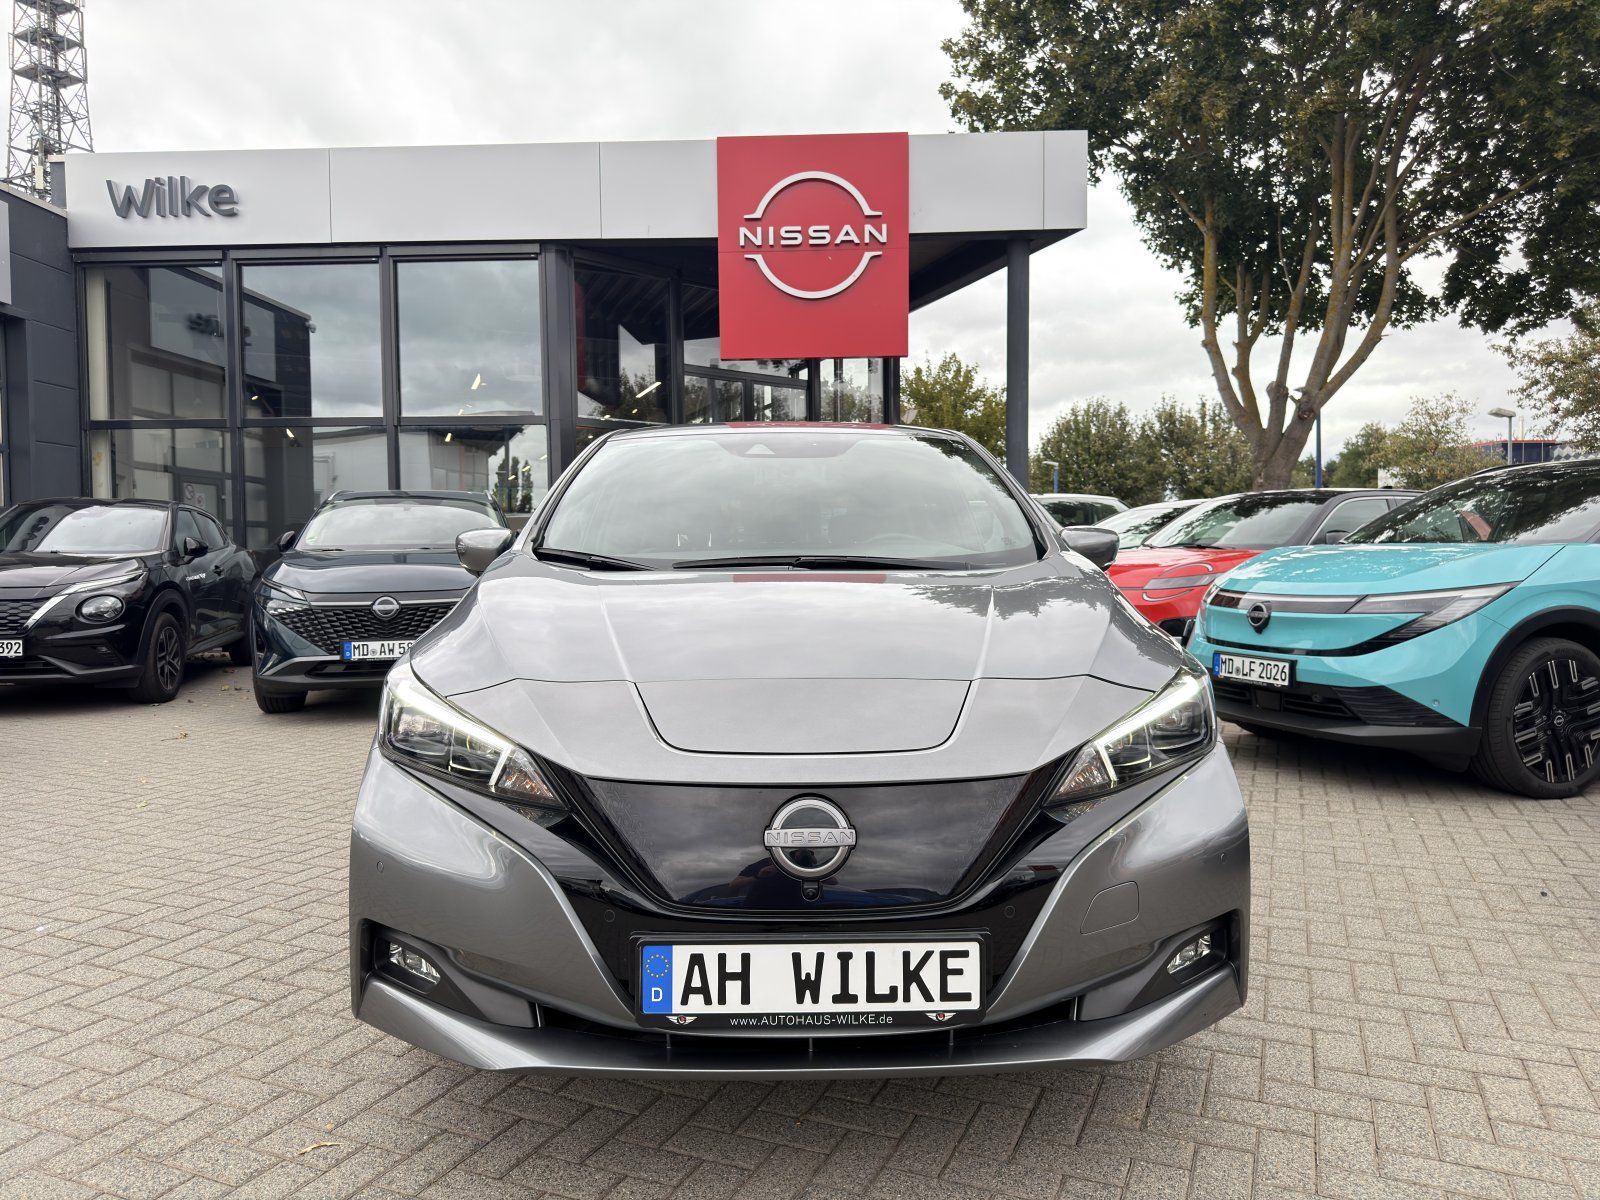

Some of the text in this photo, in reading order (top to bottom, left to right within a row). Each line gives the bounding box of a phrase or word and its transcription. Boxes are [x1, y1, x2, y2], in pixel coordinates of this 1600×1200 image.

[106, 176, 239, 218] Wilke
[739, 224, 888, 247] NISSAN
[353, 644, 369, 656] MD
[380, 643, 395, 655] AW
[1221, 658, 1287, 682] MD LF 2026
[766, 831, 855, 844] NISSAN
[680, 950, 973, 1006] AH WILKE
[651, 988, 663, 1002] D
[730, 1014, 893, 1026] www.AUTOHAUS-WILKE.de
